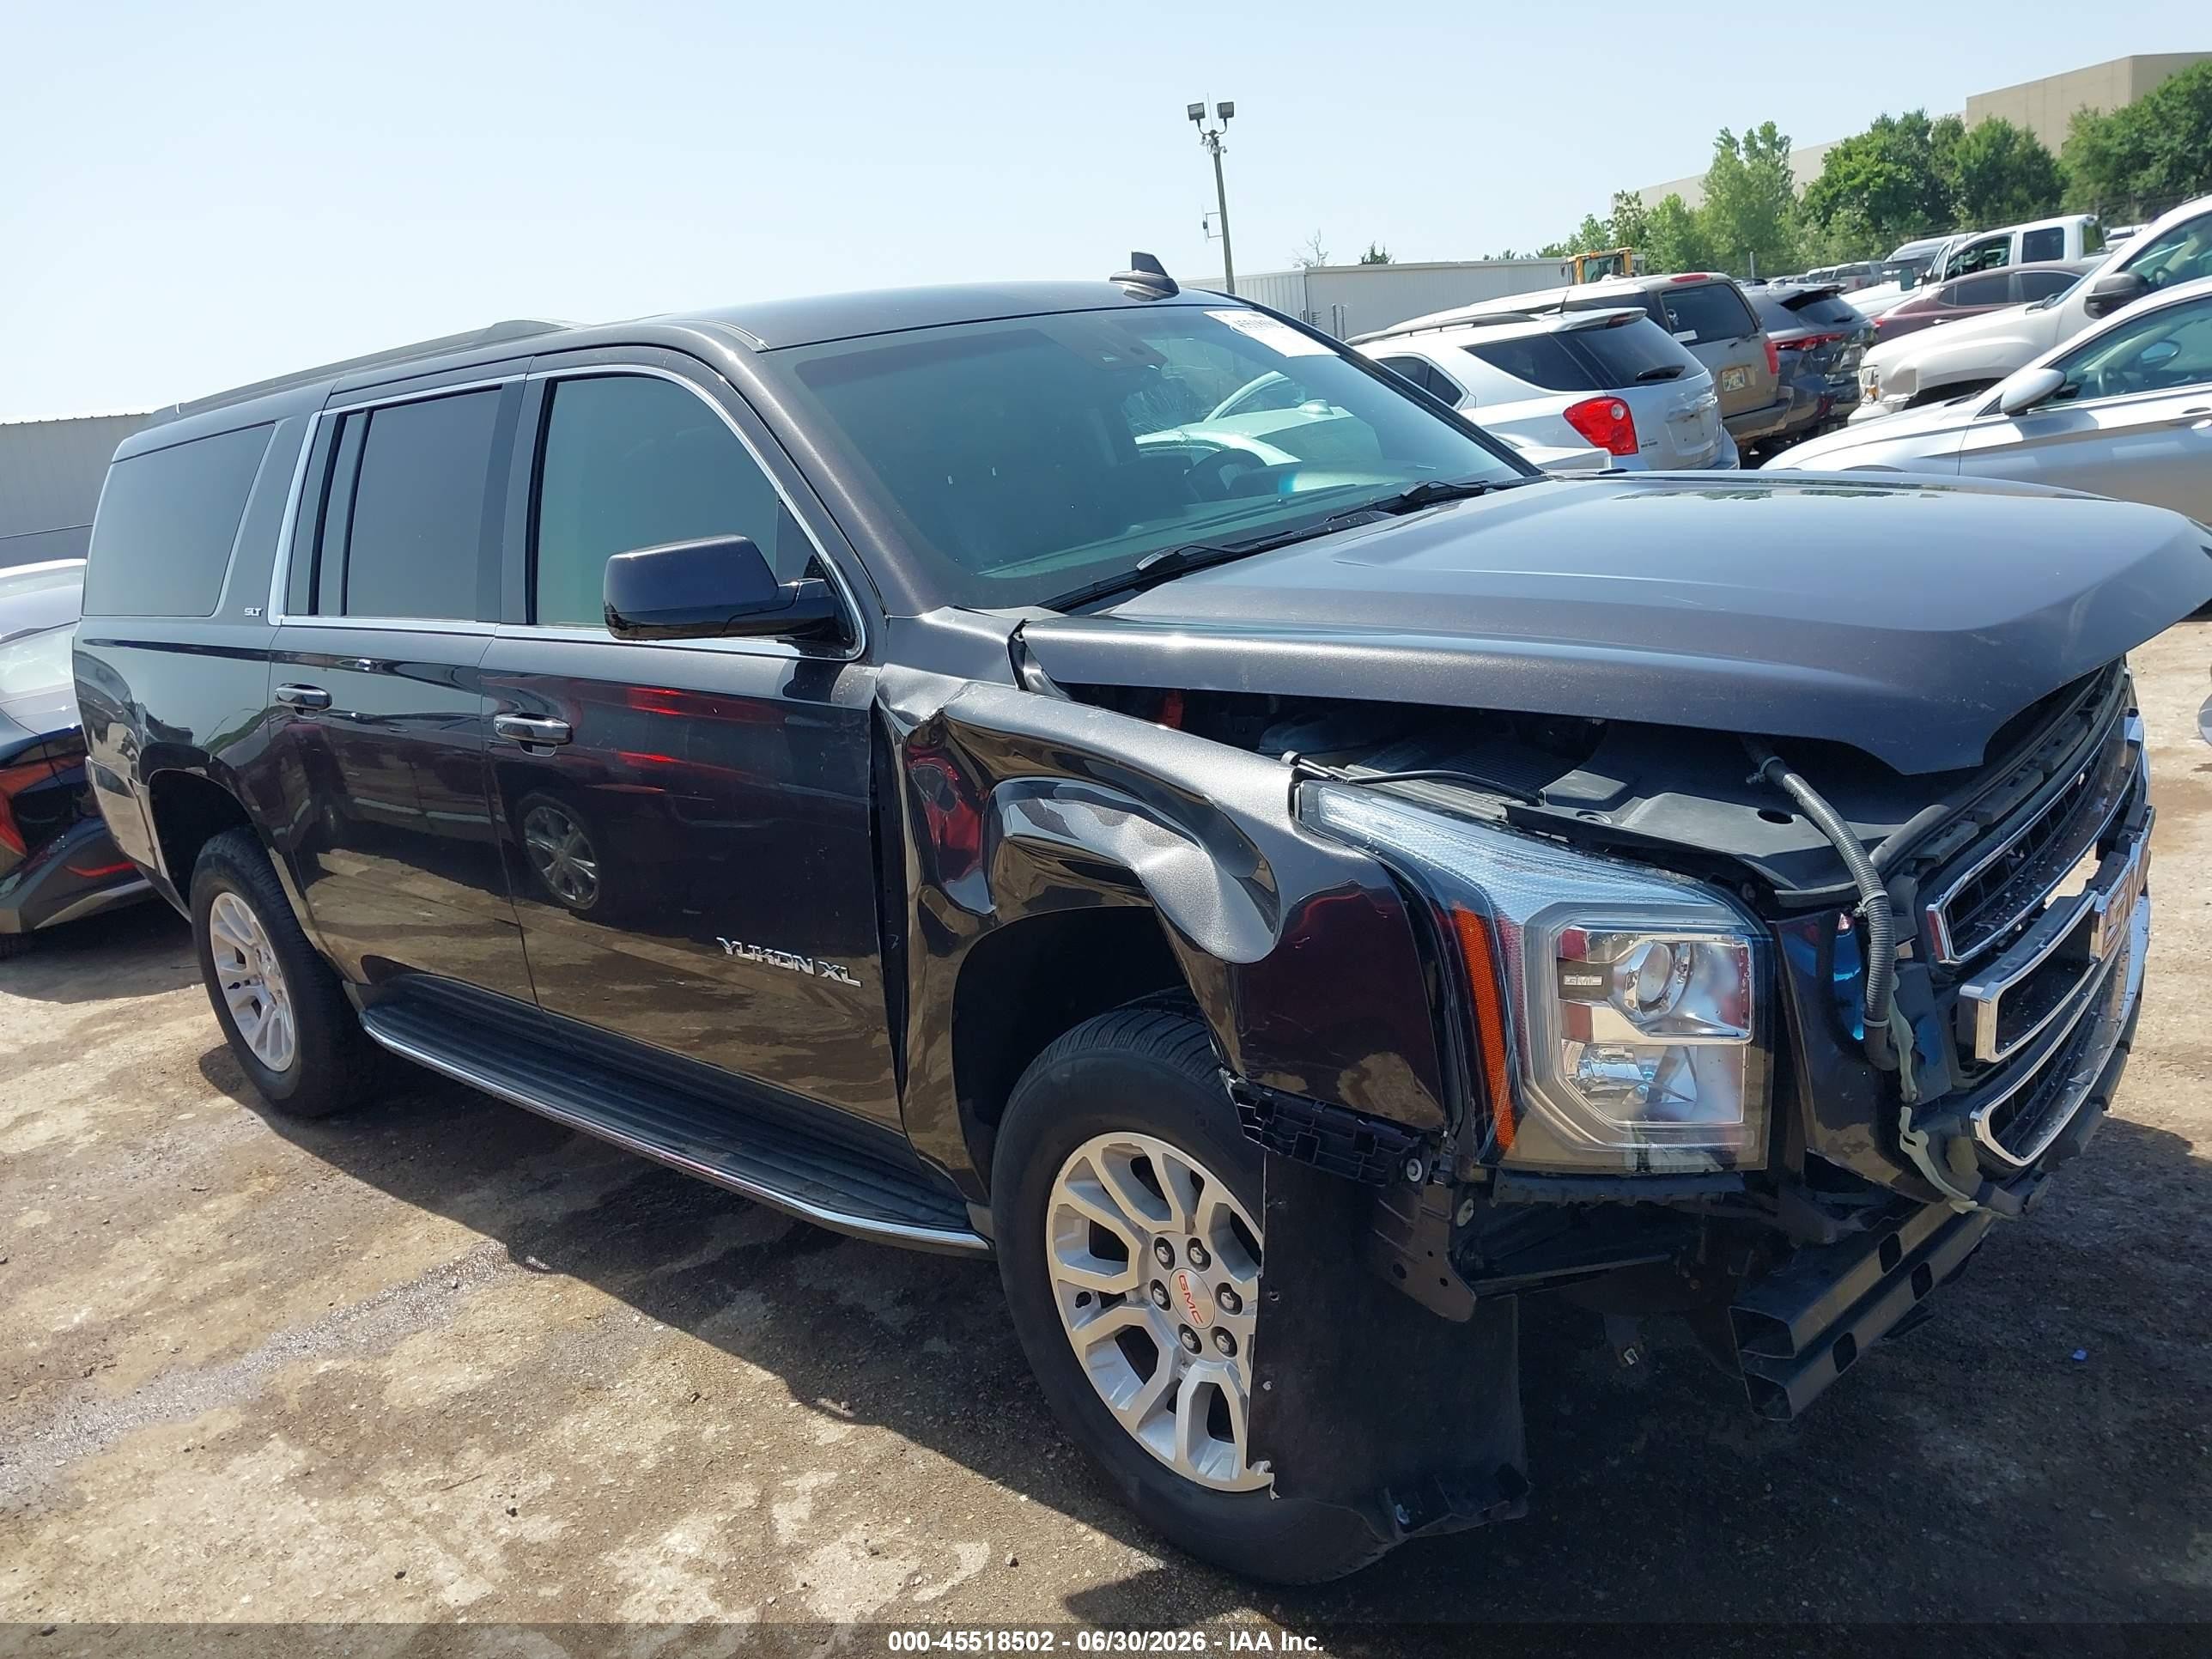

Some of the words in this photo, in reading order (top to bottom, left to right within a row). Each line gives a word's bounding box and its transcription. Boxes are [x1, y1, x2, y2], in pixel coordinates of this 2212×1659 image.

[244, 607, 263, 617] SLT
[716, 936, 815, 975] YUKON
[817, 961, 861, 988] XL
[1564, 975, 1602, 986] GMC
[1178, 1274, 1204, 1324] GMC
